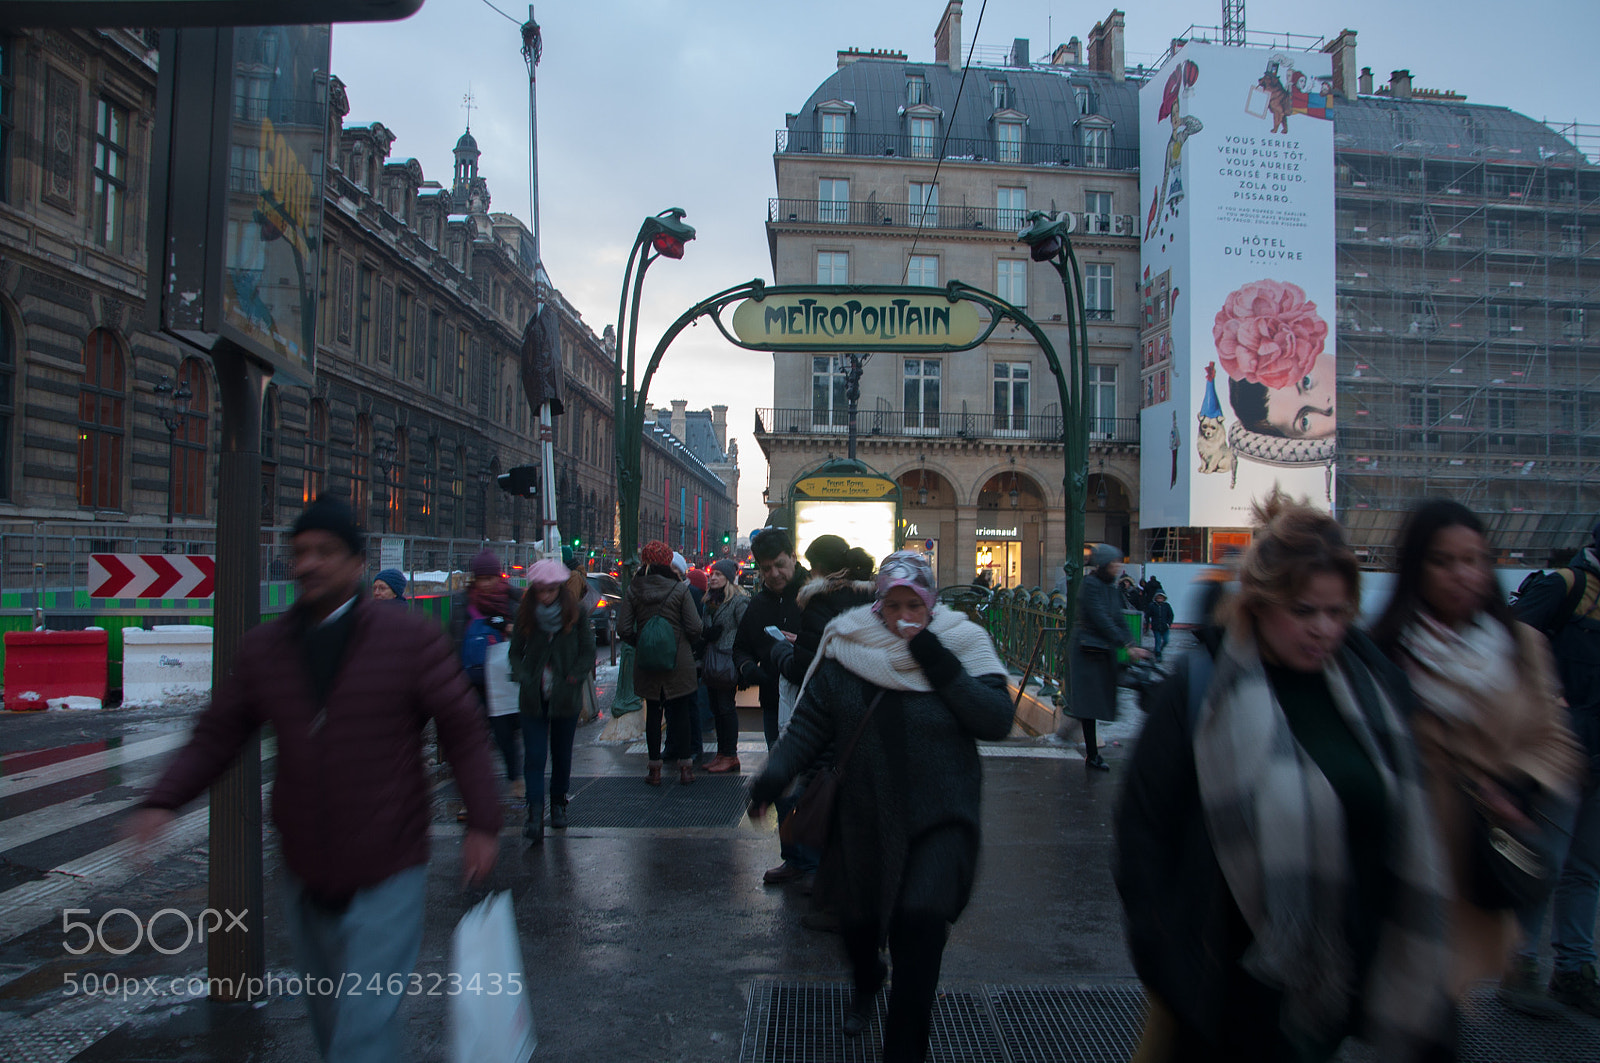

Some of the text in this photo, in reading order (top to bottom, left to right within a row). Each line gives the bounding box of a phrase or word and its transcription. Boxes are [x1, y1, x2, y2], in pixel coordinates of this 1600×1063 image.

[1225, 136, 1300, 149] VOUS SERIEZ
[1217, 146, 1247, 155] VENU
[1252, 149, 1279, 158] PLUS
[1226, 158, 1300, 171] VOUS AURIEZ
[1219, 168, 1260, 179] CROISÉ
[1239, 180, 1287, 192] ZOLA OU
[1233, 191, 1293, 203] PISSARRO.
[1028, 209, 1140, 236] OTEL
[1242, 234, 1286, 248] HÔTEL
[1224, 246, 1303, 261] DU LOUVRE
[764, 298, 951, 340] METROPOLITAIN
